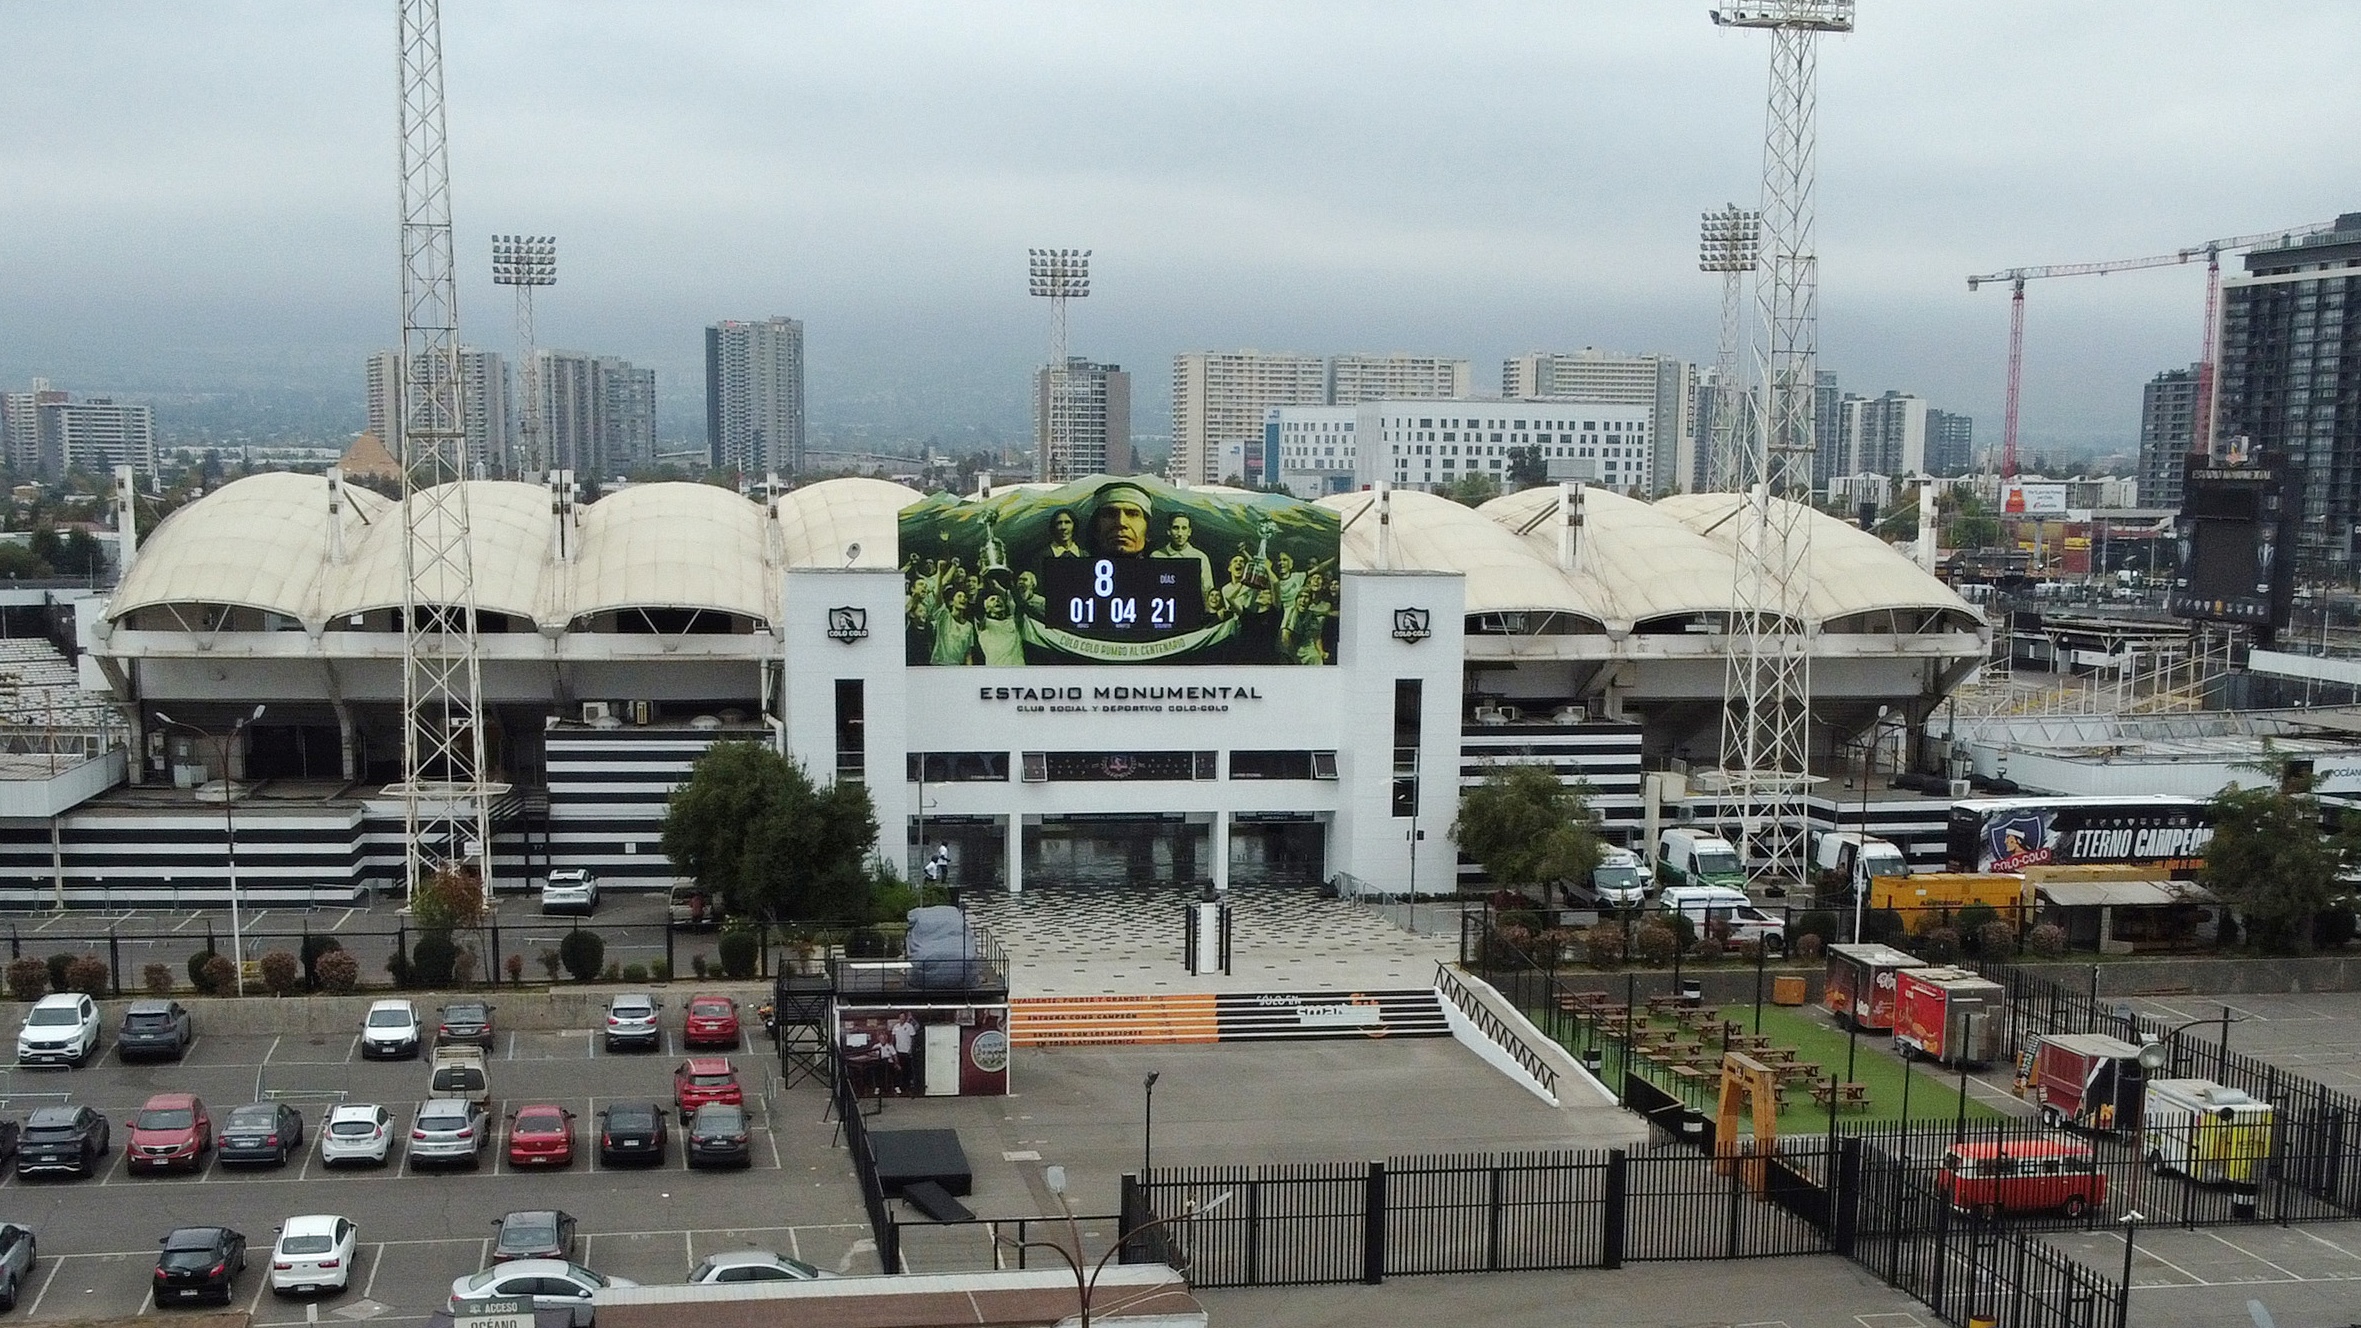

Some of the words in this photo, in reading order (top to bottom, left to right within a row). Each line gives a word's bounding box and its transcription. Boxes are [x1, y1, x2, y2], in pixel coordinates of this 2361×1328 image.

[1094, 559, 1114, 597] 8
[1160, 573, 1176, 584] DÍAS
[1070, 597, 1095, 623] 01
[1110, 597, 1137, 623] 04
[1151, 597, 1176, 623] 21
[979, 687, 1083, 701] ESTADIO
[1094, 686, 1263, 700] MONUMENTAL
[2071, 829, 2133, 858] ETERNO
[1993, 849, 2048, 871] COLO-COLO
[485, 1302, 518, 1314] ACCESO
[470, 1318, 517, 1328] OCÉANO
